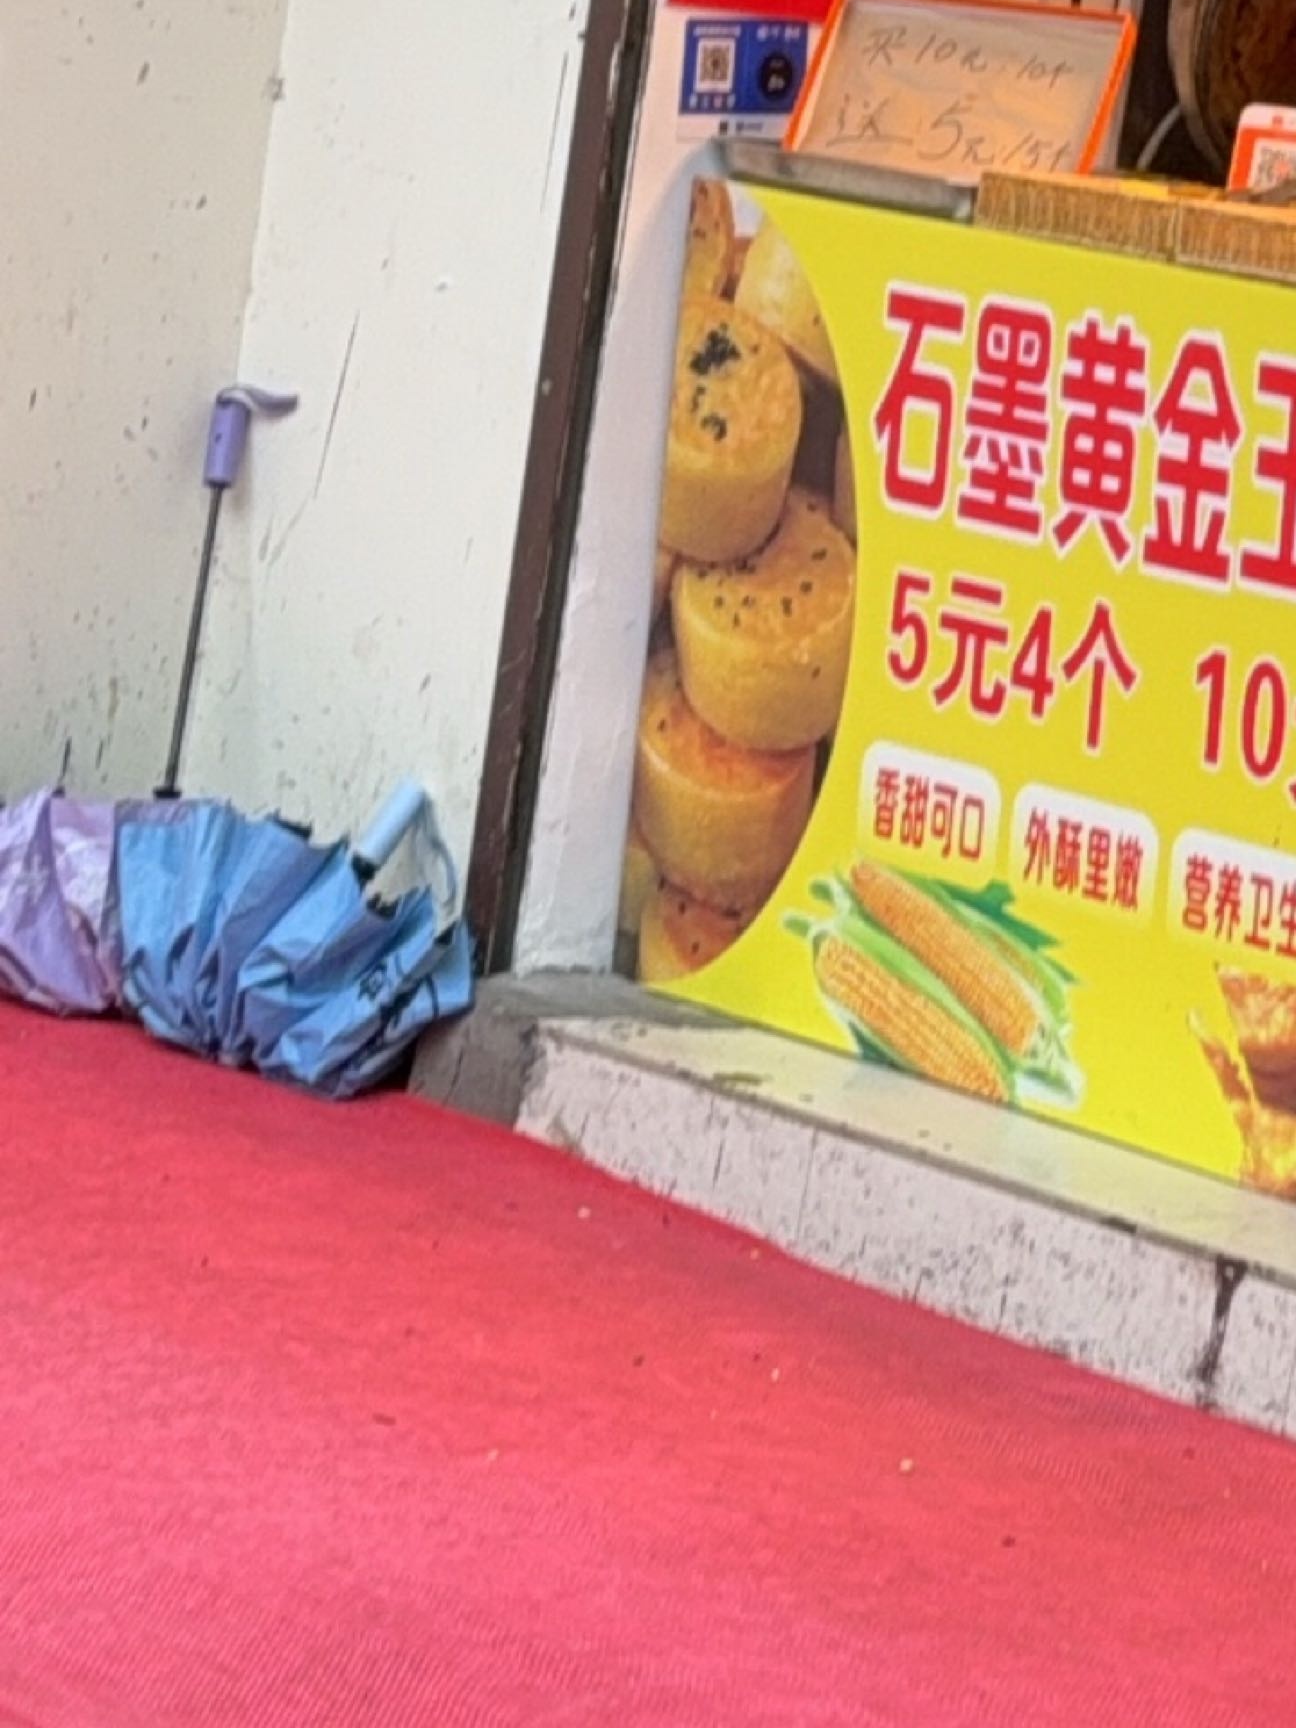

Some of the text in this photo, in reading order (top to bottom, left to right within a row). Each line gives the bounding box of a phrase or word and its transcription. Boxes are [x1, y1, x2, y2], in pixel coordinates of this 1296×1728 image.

[885, 571, 1139, 753] 5元4个
[872, 766, 984, 863] 香甜可口
[1023, 806, 1145, 912] 外酥里嫩
